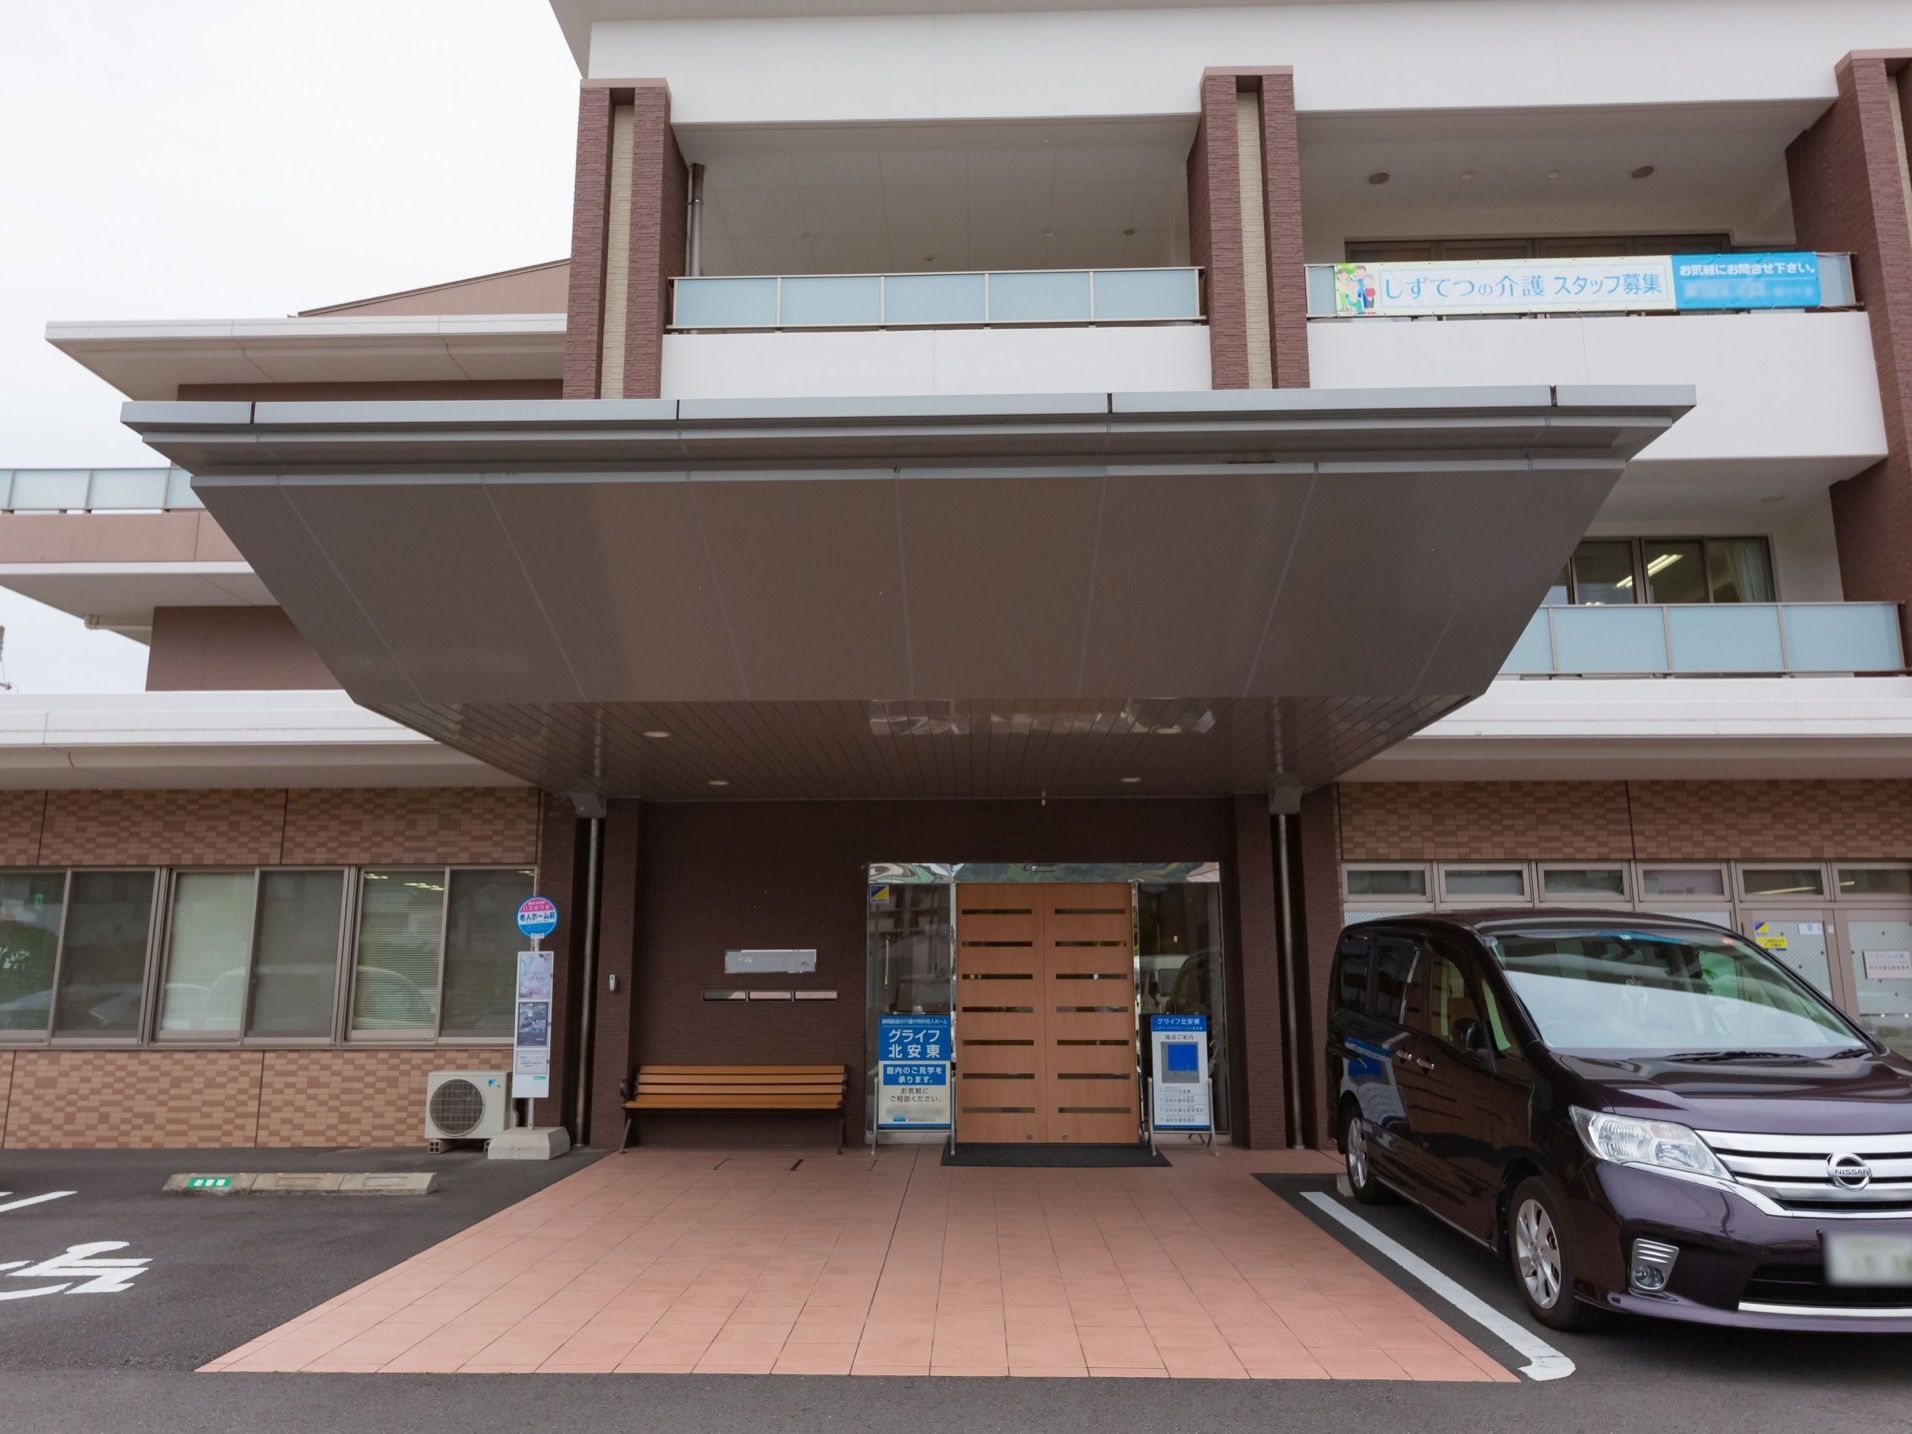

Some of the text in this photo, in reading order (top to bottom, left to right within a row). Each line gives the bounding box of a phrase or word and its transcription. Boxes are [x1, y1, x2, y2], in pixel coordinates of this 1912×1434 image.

[1679, 262, 1816, 276] お気軽にお問合せ下さい。
[1385, 275, 1546, 300] しずてつの介護
[1553, 272, 1662, 296] スタッフ募集
[888, 1028, 940, 1043] グライフ
[888, 1044, 941, 1058] 北安東
[1834, 1168, 1871, 1176] NISSAN
